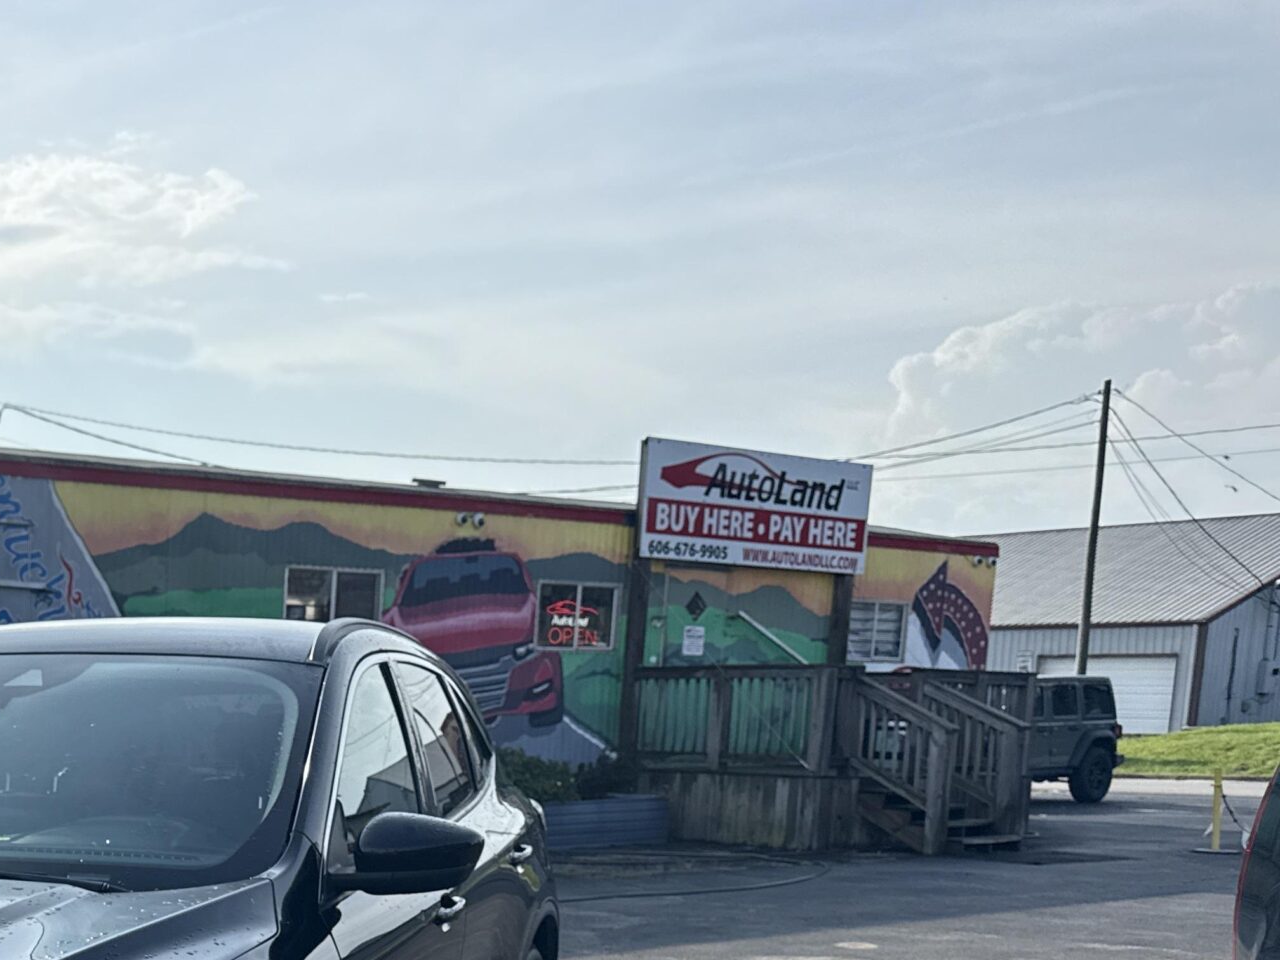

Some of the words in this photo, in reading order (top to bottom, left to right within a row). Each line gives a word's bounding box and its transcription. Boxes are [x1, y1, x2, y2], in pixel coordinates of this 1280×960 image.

[704, 463, 846, 512] AutoLand
[655, 502, 702, 534] BUY
[702, 507, 756, 539] HERE
[768, 514, 808, 543] PAY
[808, 519, 858, 549] HERE
[648, 540, 729, 560] 606-676-9905
[742, 548, 859, 571] WWW.AUTOLANDLLC.COM
[547, 626, 598, 646] OPEN
